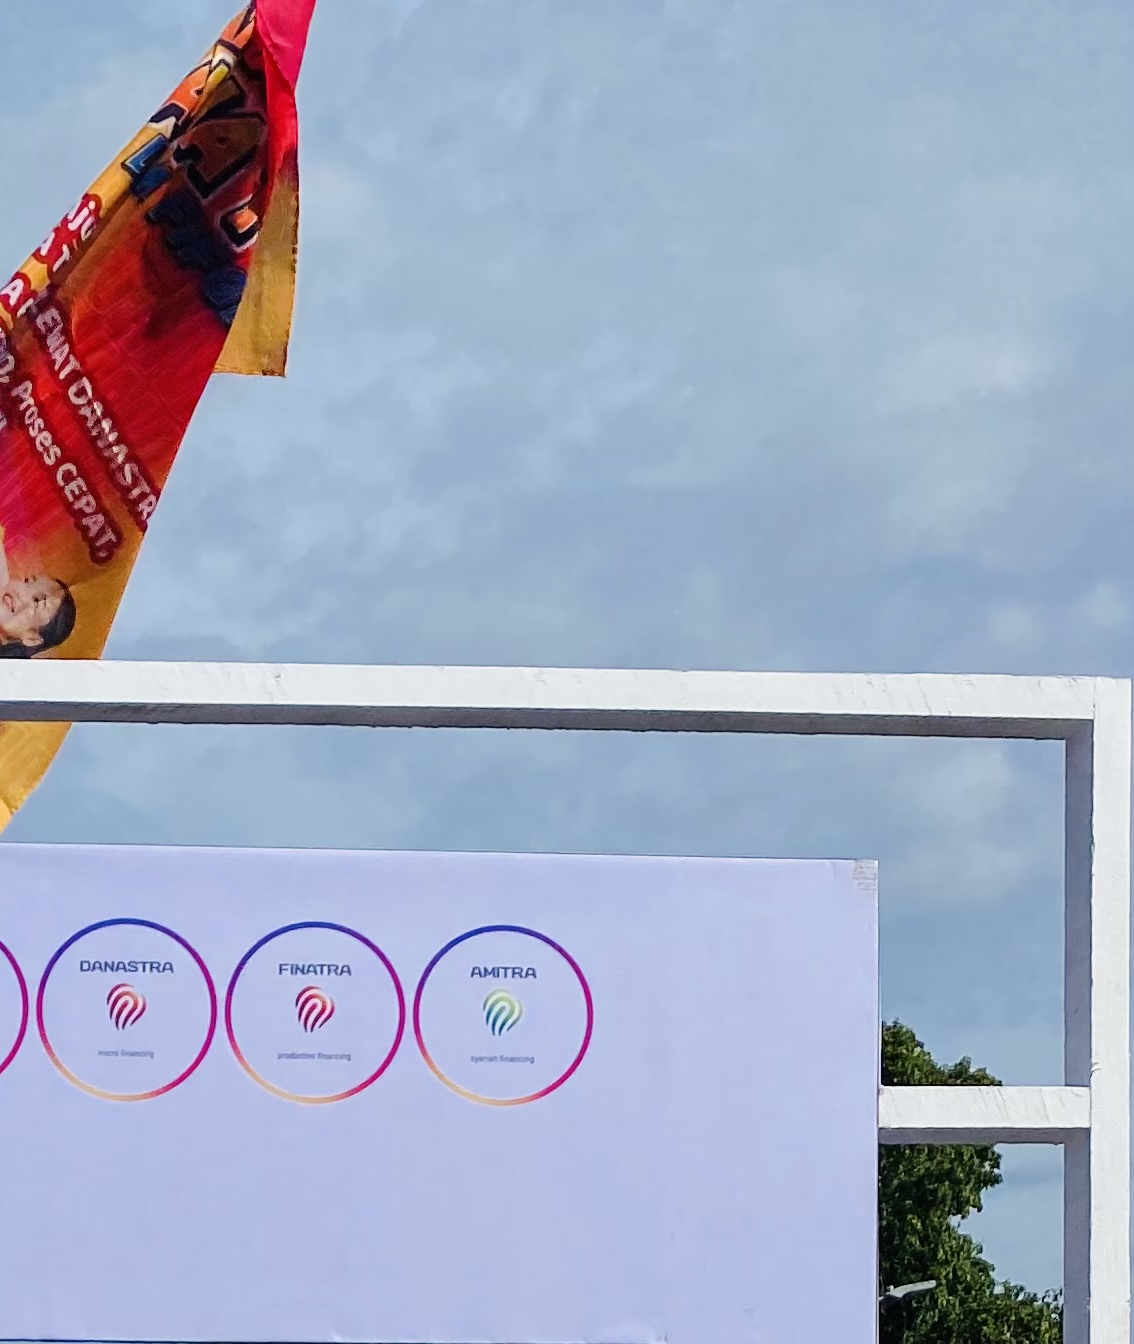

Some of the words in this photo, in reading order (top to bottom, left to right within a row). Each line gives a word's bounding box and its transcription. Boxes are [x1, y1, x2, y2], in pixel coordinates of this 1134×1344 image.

[11, 380, 62, 466] Proses
[79, 960, 174, 974] DANASTRA
[278, 962, 352, 977] FINATRA
[470, 965, 537, 980] AMITRA
[120, 1050, 154, 1059] financing
[317, 1052, 351, 1061] financing
[499, 1055, 535, 1064] financing
